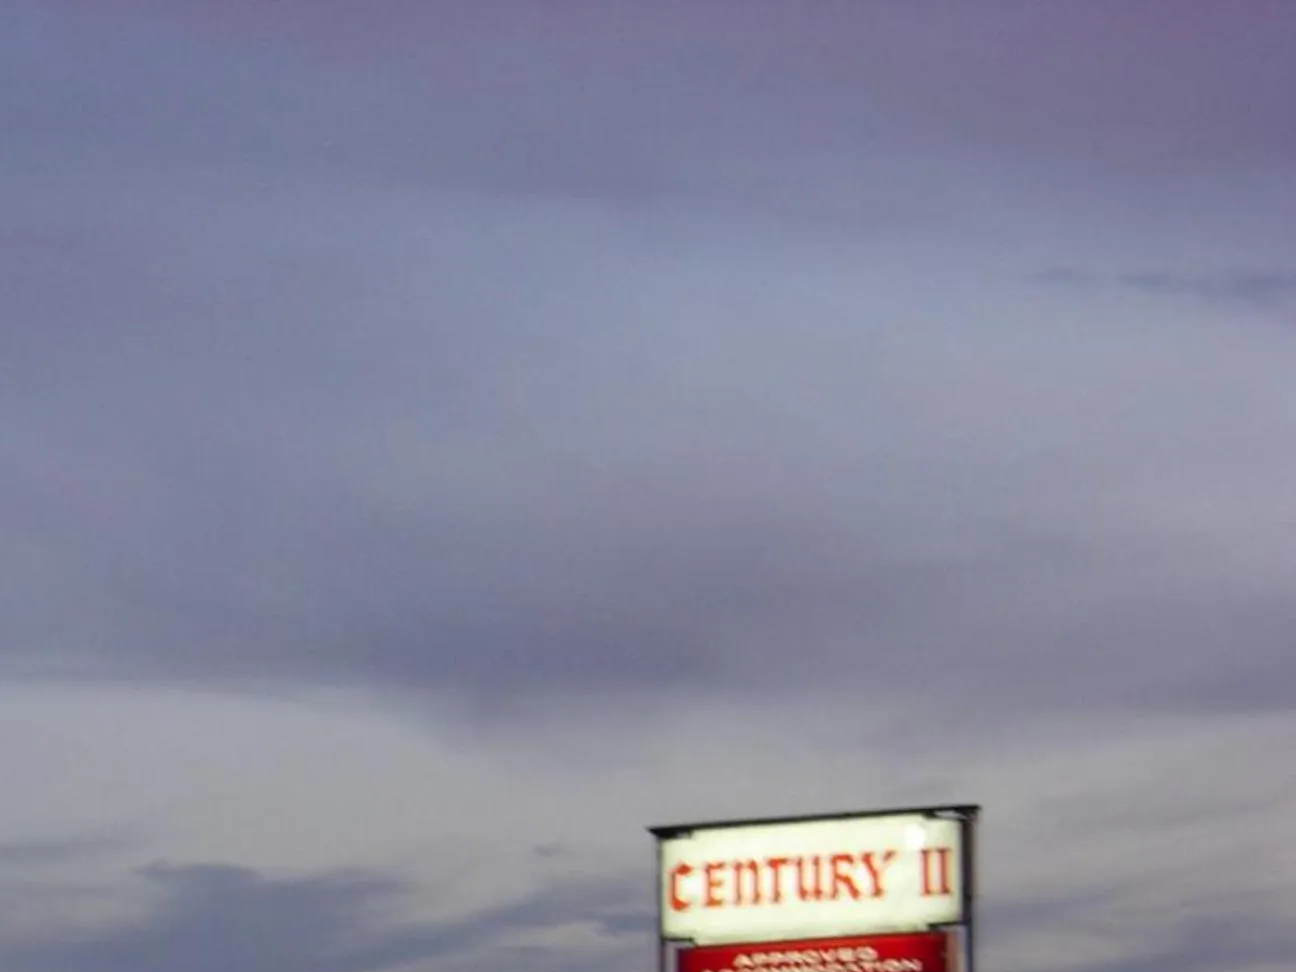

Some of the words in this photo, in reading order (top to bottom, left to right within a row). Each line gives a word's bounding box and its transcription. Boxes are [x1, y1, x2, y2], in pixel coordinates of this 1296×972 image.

[669, 850, 895, 911] CENTURY
[921, 848, 953, 896] II
[734, 947, 878, 968] APPROVED
